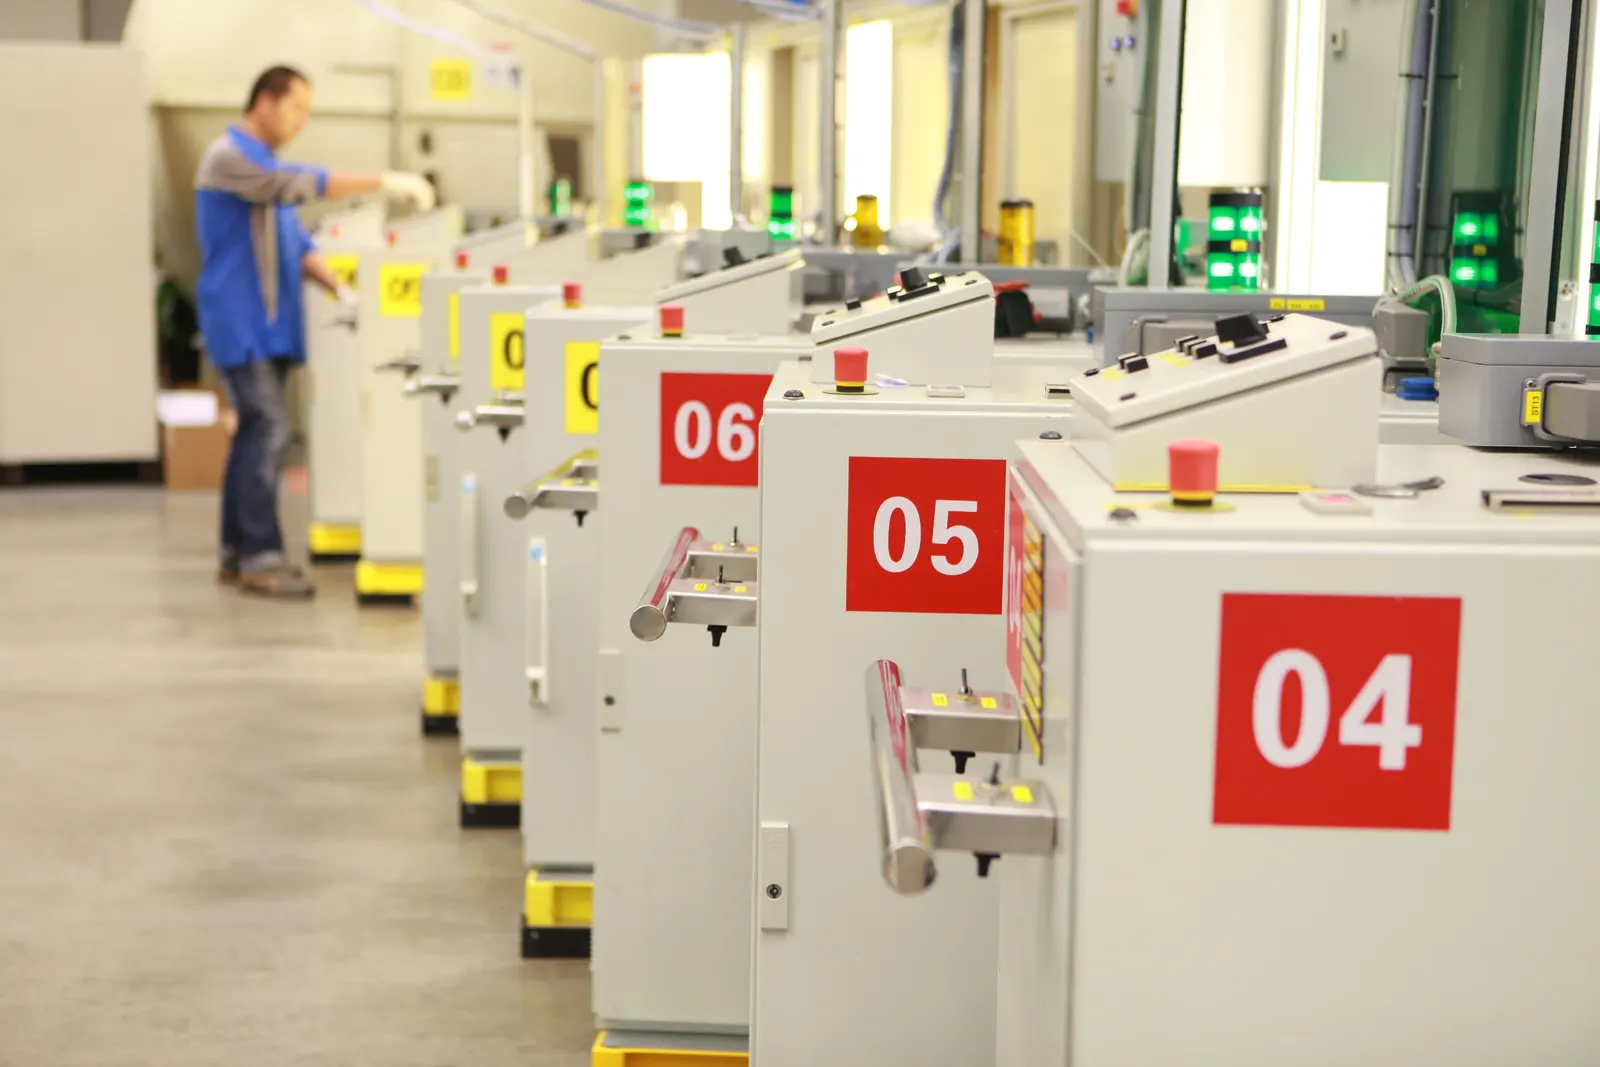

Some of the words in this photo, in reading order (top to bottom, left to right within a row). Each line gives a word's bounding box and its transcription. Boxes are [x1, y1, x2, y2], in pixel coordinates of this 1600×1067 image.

[674, 400, 756, 462] 06
[1531, 396, 1540, 416] ST13
[873, 496, 979, 576] 05
[1252, 648, 1423, 770] 04
